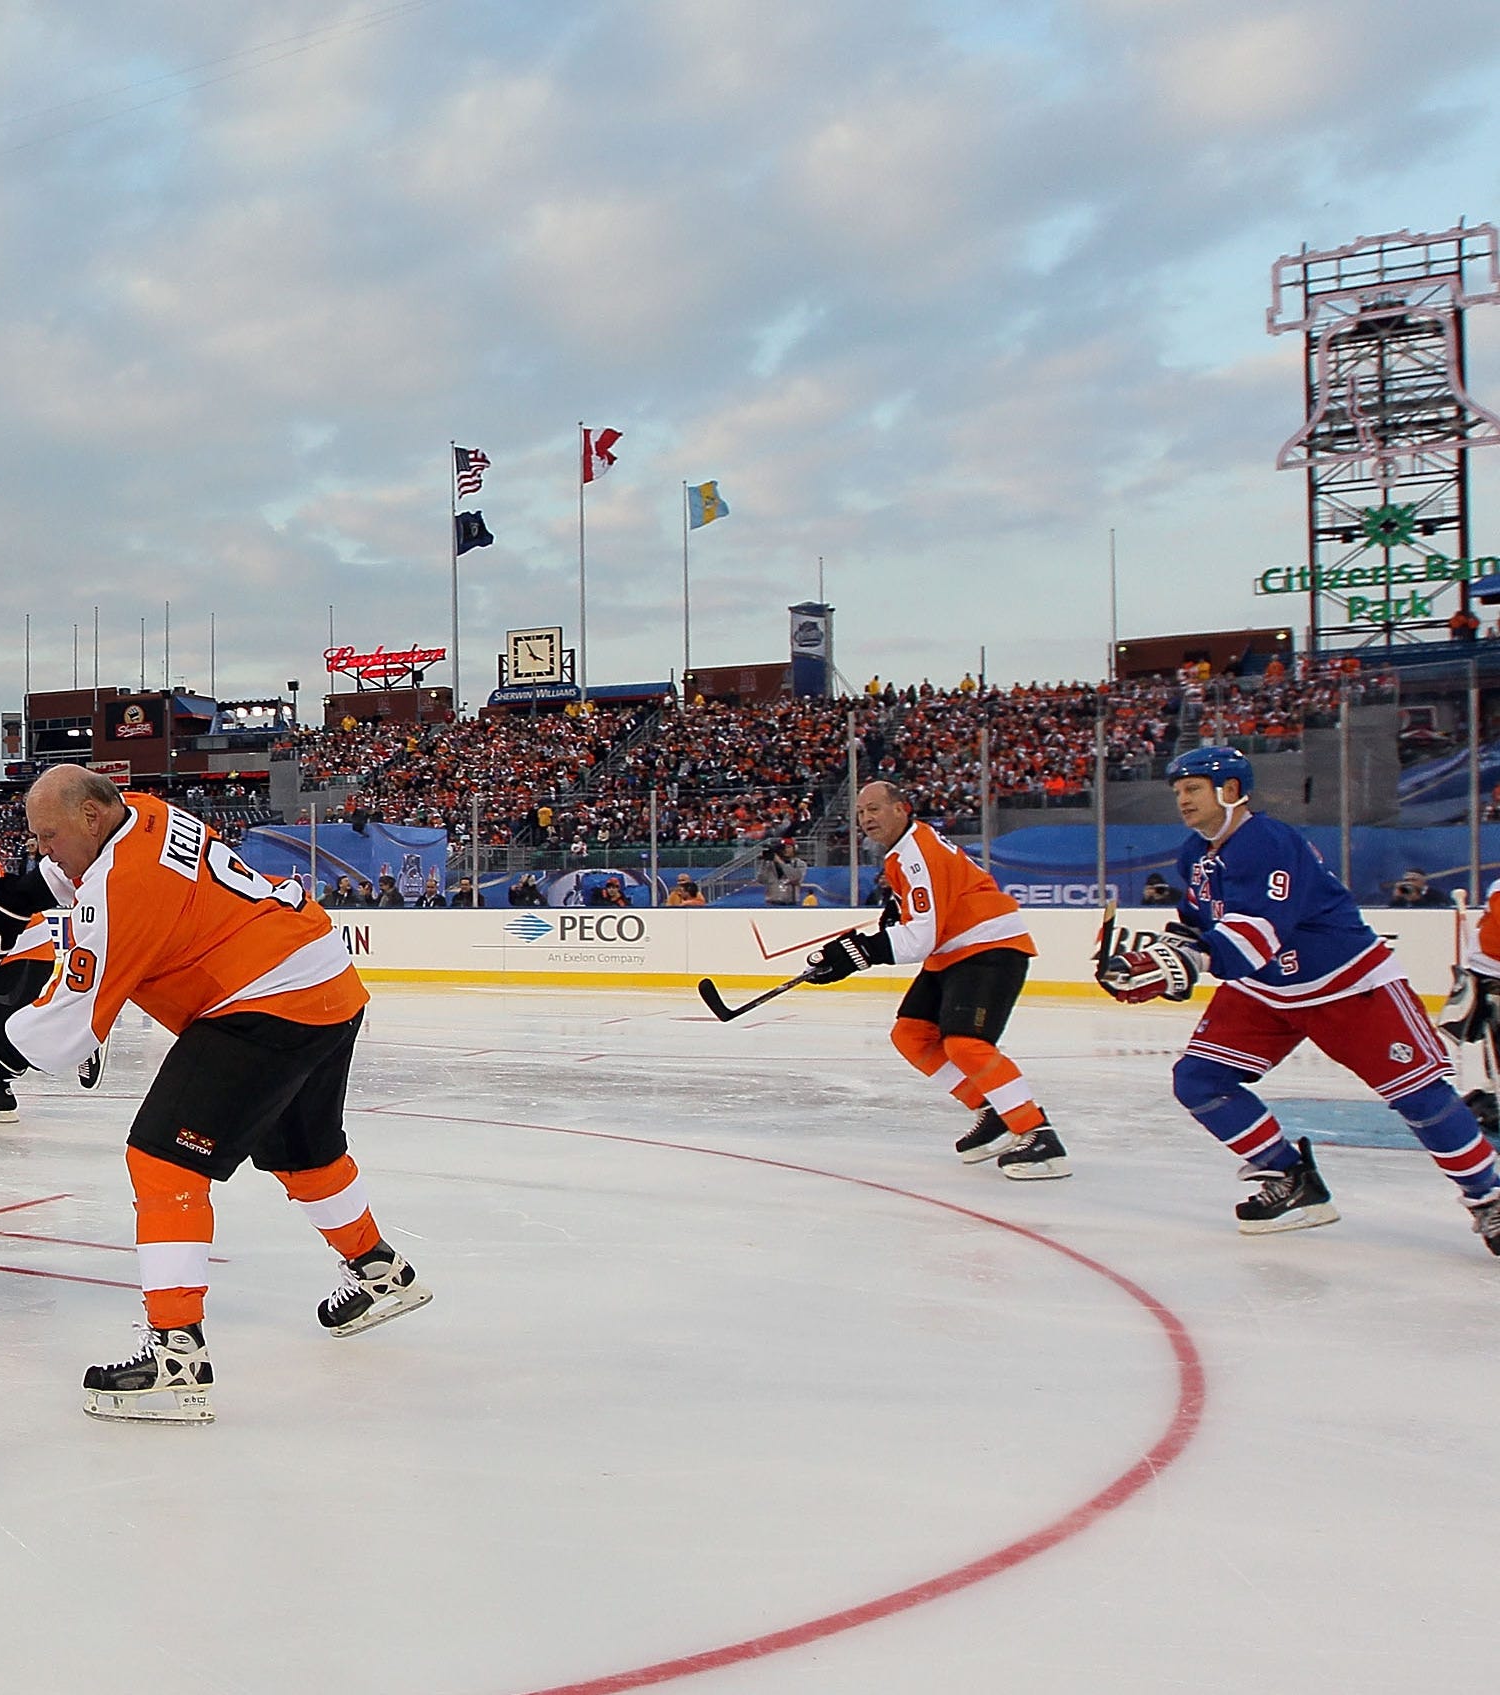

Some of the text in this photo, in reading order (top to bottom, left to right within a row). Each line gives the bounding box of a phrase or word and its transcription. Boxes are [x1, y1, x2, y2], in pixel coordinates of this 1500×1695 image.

[1261, 553, 1500, 594] Citizens Ban
[1348, 590, 1432, 623] Park
[494, 688, 577, 701] SHERWIN WILLIAMS
[166, 808, 202, 871] KELLY
[910, 863, 921, 874] 10
[1004, 884, 1119, 905] GEICO
[1267, 870, 1290, 901] 9
[911, 887, 931, 913] 8
[80, 906, 95, 923] 10
[559, 915, 645, 942] PECO
[66, 946, 98, 993] 9
[548, 953, 645, 965] An Exelon Company
[1156, 948, 1187, 992] Baue
[176, 1137, 212, 1156] EASTON
